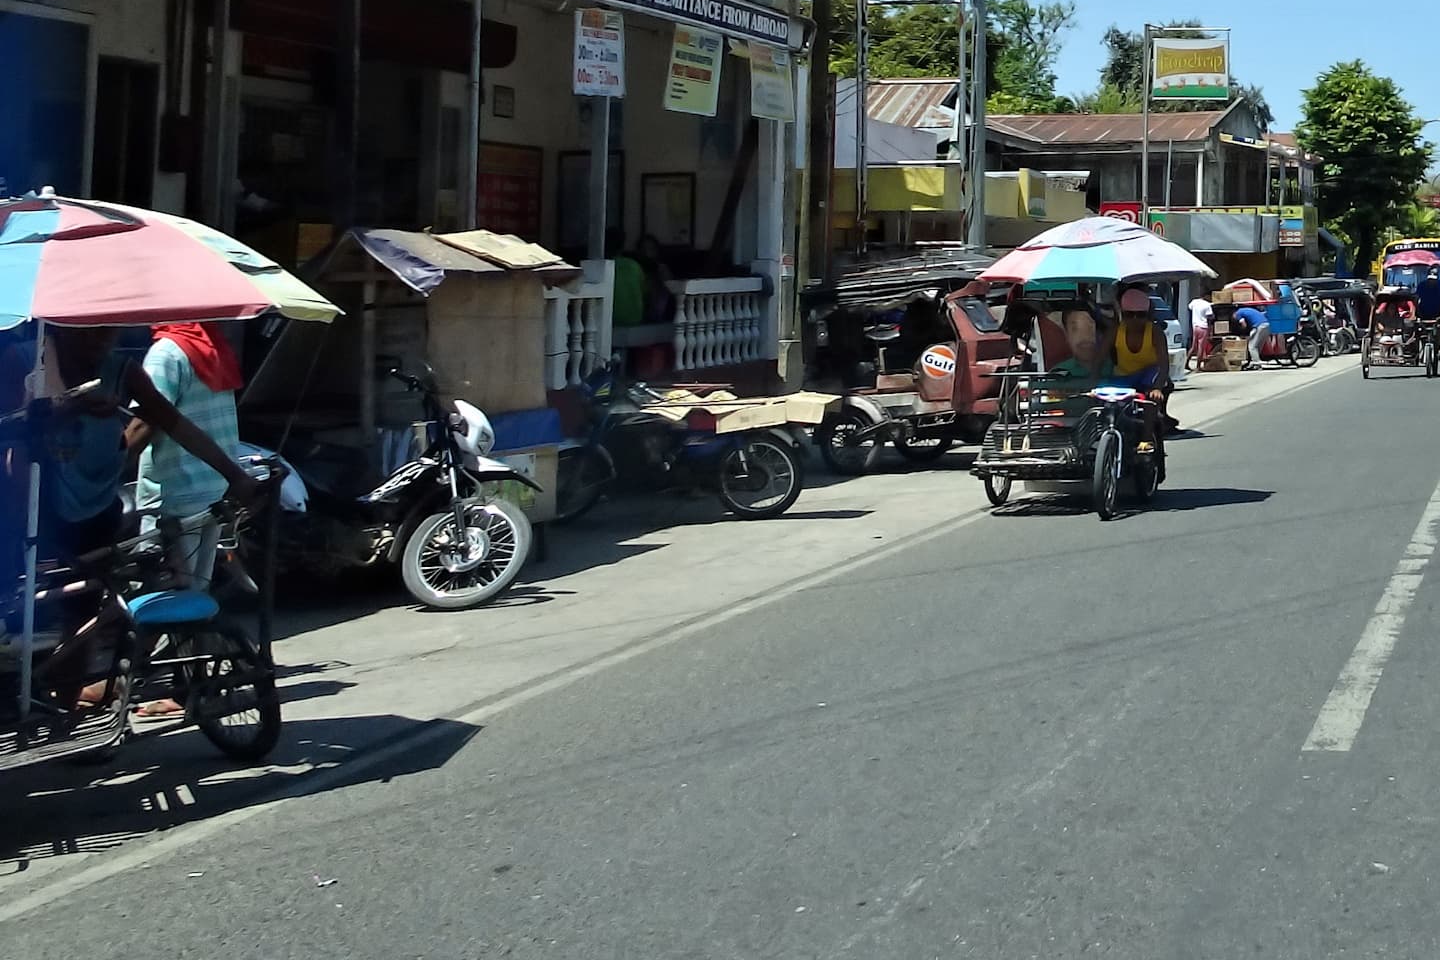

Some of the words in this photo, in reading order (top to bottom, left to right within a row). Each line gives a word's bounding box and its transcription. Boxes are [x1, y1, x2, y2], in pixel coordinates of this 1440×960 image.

[722, 4, 751, 30] FROM
[750, 14, 789, 38] ABROAD
[924, 354, 955, 371] Gulf
